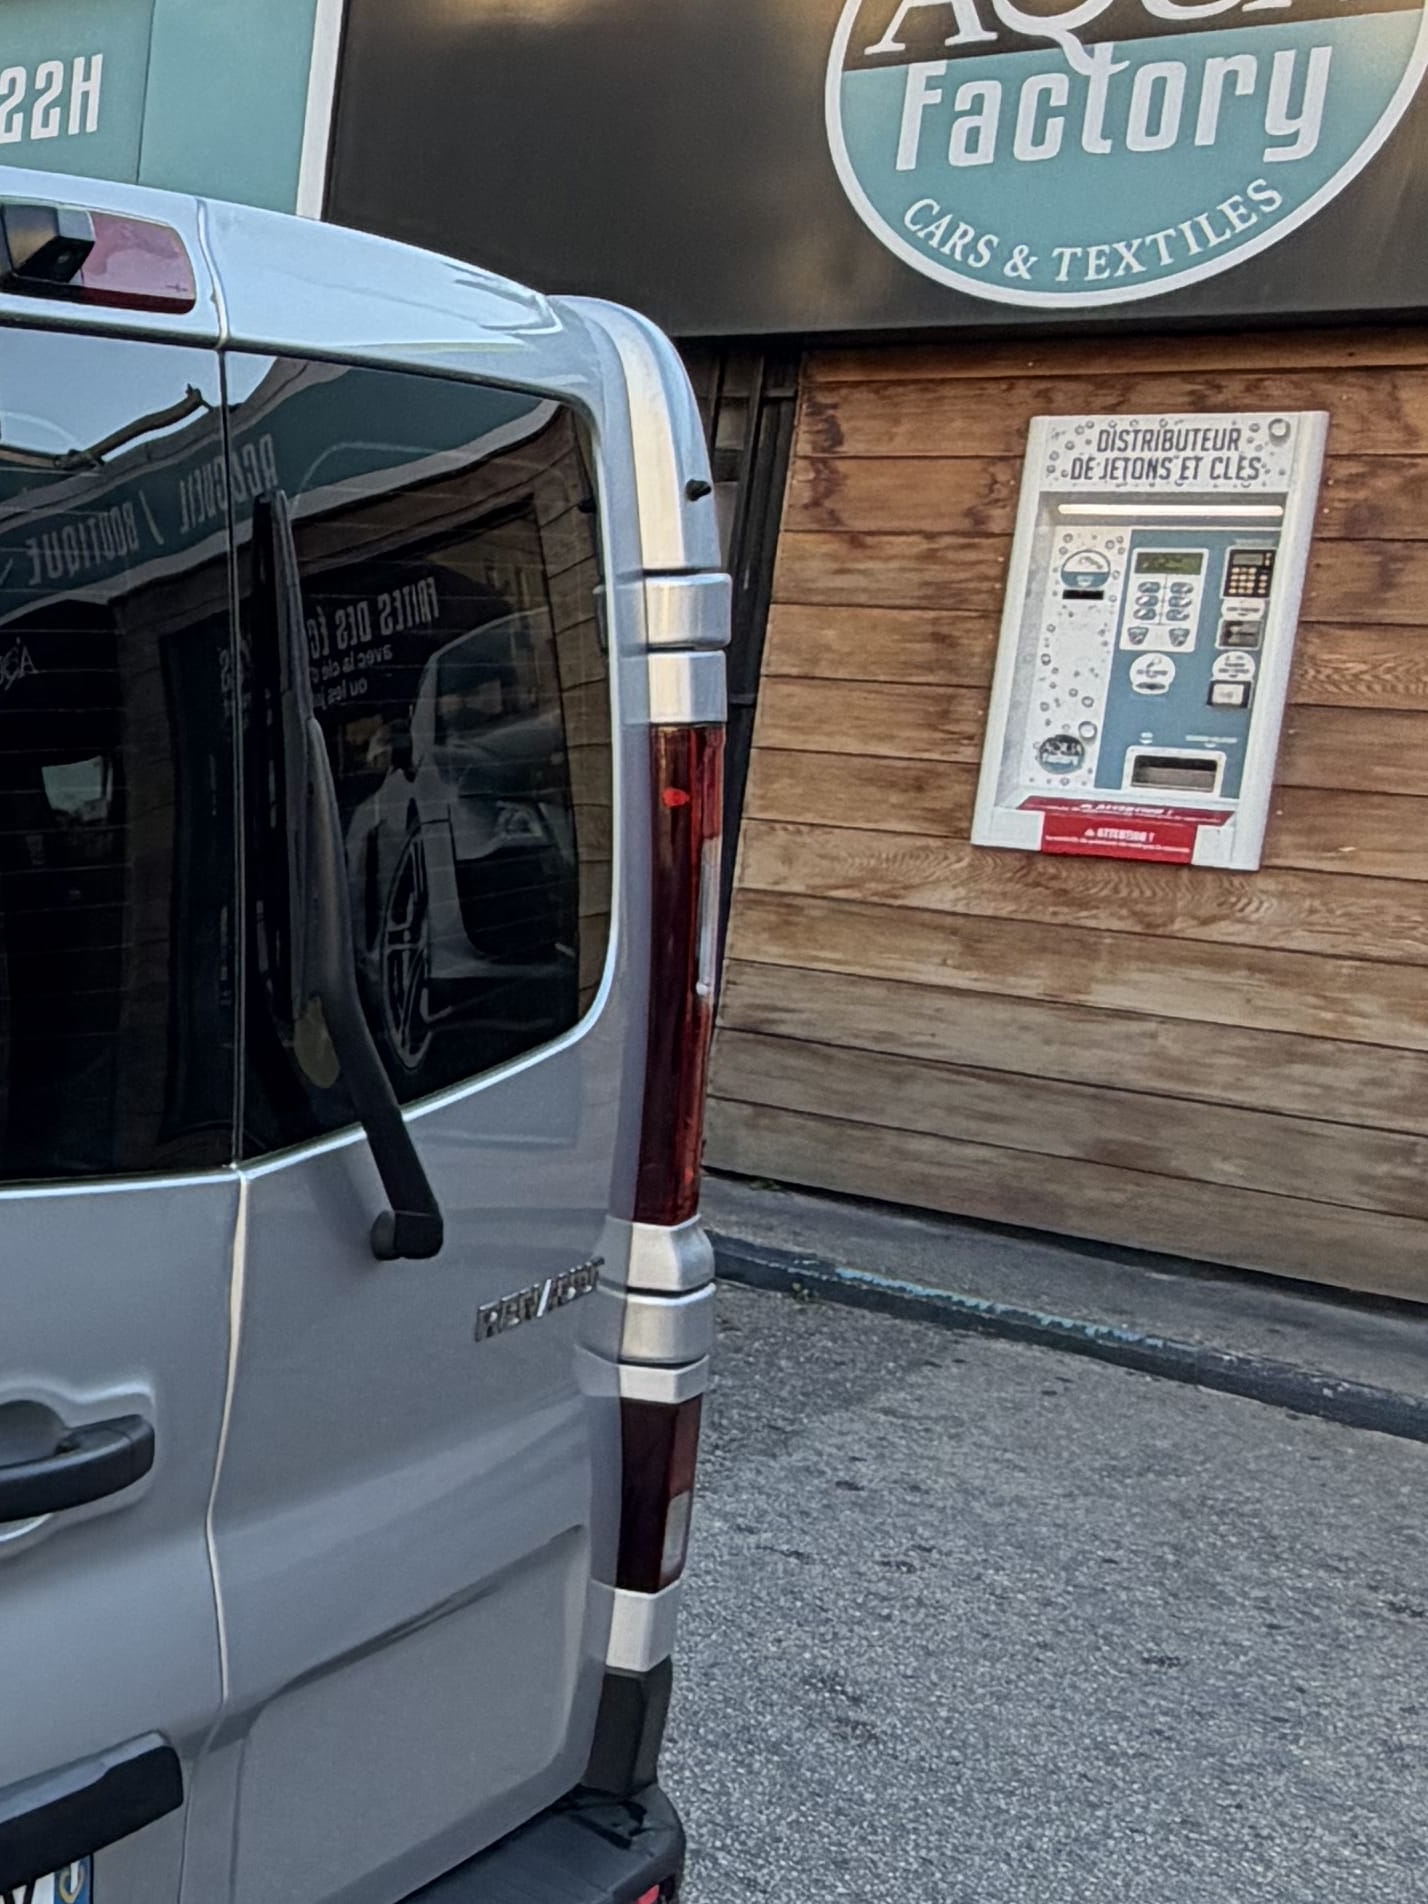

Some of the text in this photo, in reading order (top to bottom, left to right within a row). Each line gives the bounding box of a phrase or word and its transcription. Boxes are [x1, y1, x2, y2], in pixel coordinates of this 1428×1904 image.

[896, 42, 1332, 171] Factory
[904, 178, 1284, 283] CARS & TEXTILES
[1070, 456, 1095, 480] DE
[1098, 456, 1173, 480] JETONS
[1178, 456, 1204, 480] ET
[1097, 427, 1242, 452] DISTRIBUTEUR
